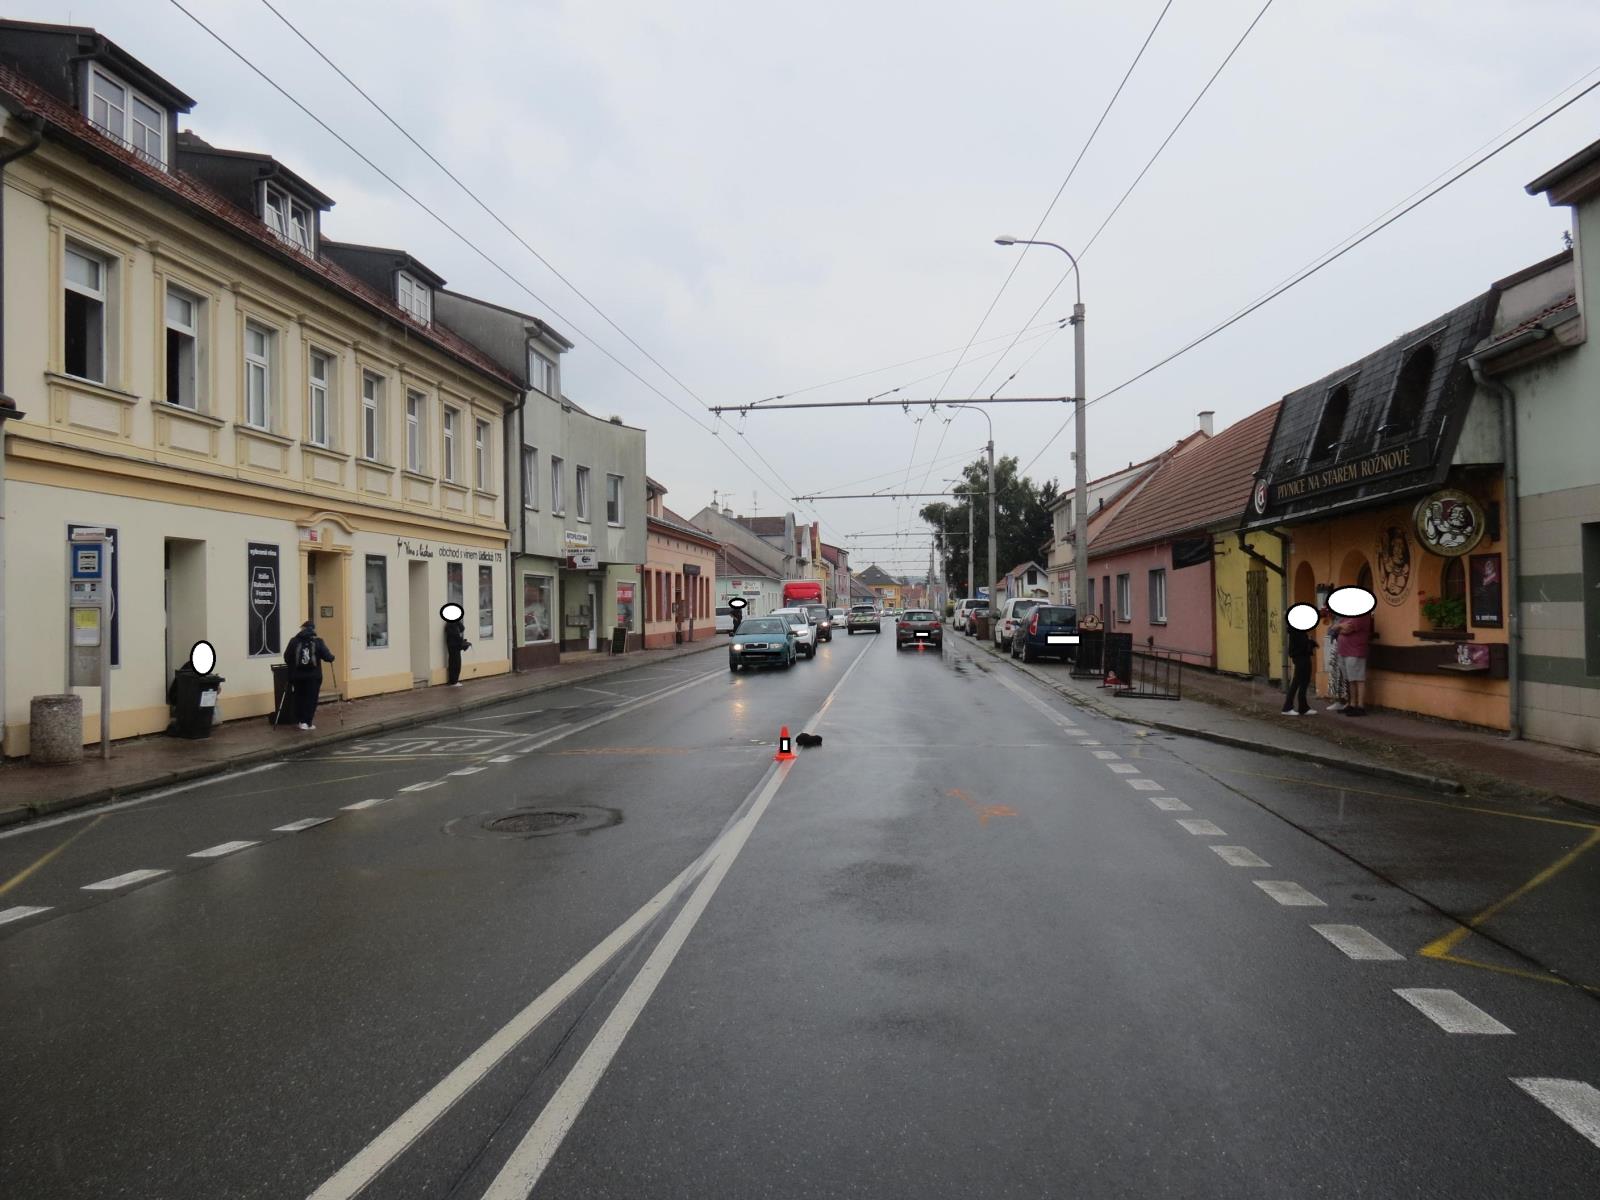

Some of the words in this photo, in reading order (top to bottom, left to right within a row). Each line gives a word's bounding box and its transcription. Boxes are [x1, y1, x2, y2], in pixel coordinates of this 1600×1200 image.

[1277, 479, 1305, 497] PIVNICE
[1308, 474, 1320, 490] NA
[439, 546, 460, 559] obchod
